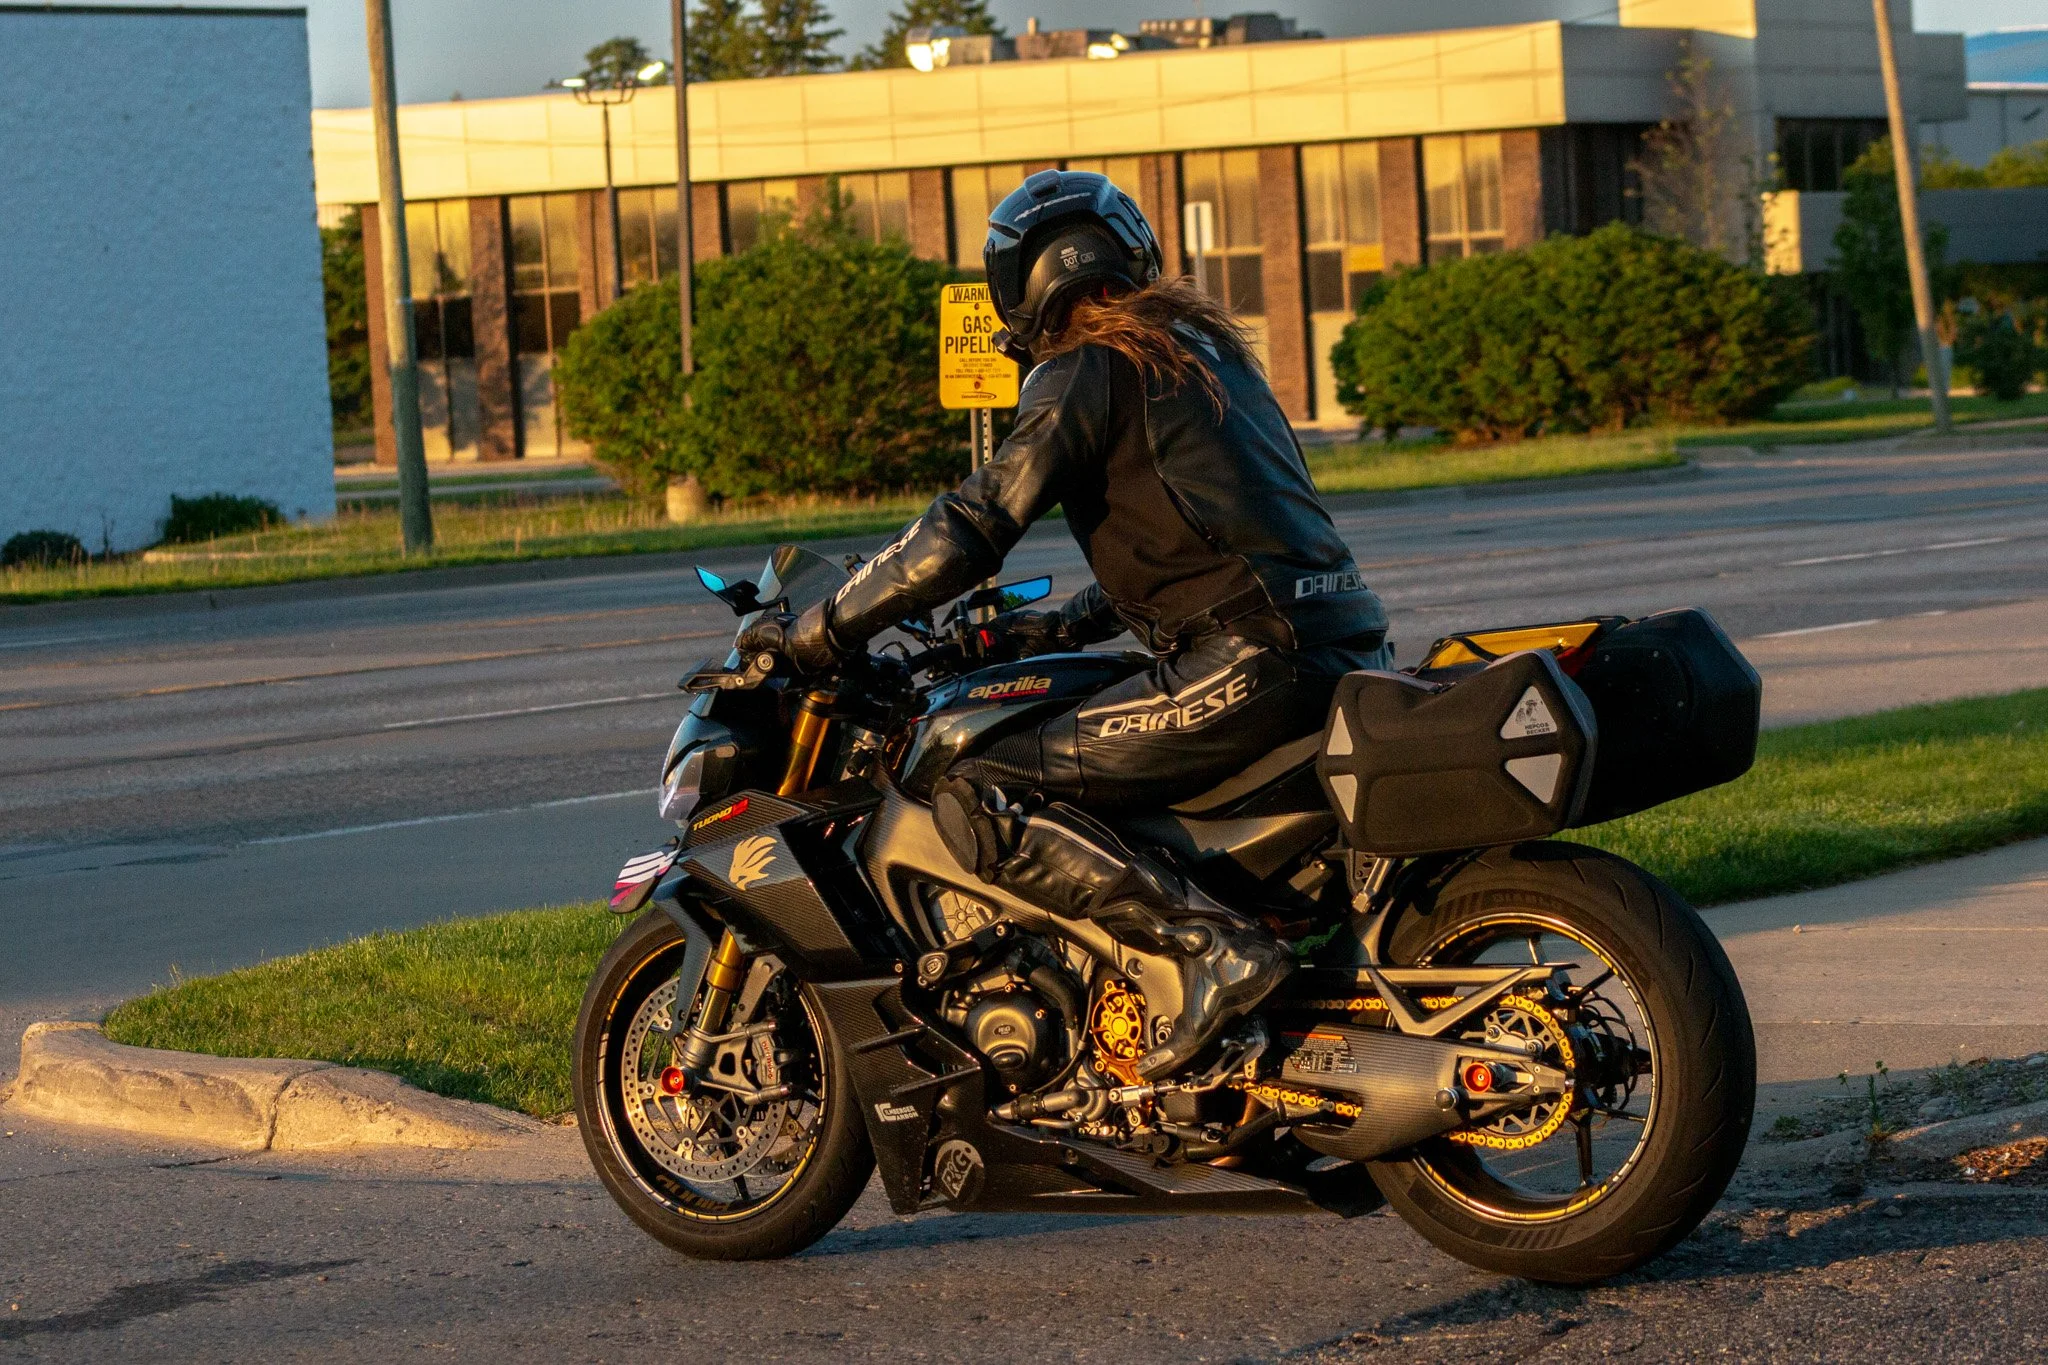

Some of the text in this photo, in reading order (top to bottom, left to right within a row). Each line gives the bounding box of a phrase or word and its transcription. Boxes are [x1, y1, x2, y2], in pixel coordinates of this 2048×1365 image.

[1063, 255, 1078, 267] DOT
[952, 287, 989, 301] WARNI
[963, 315, 992, 333] GAS
[835, 517, 923, 605] DAINESE
[967, 676, 1052, 698] aprilia
[1099, 673, 1248, 738] DAINESE
[693, 806, 733, 831] TUONO
[942, 1149, 972, 1198] R&G
